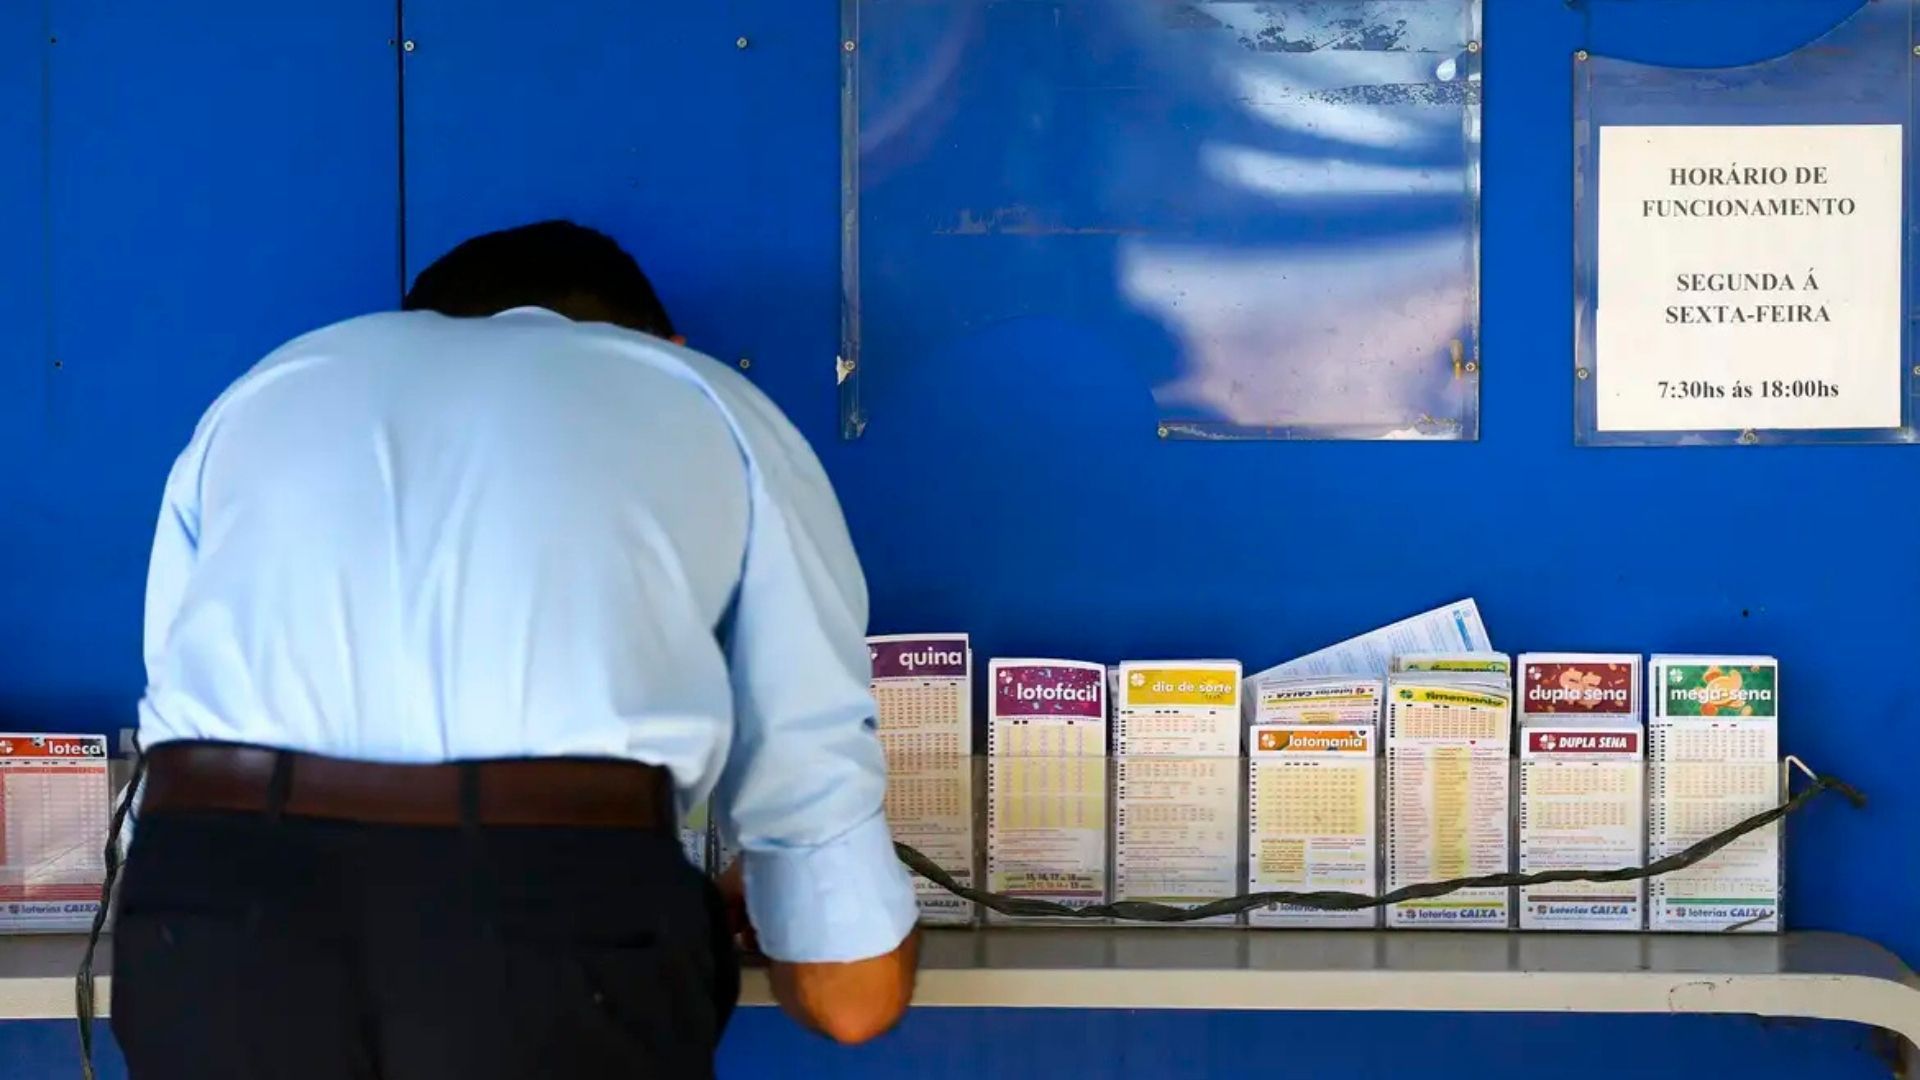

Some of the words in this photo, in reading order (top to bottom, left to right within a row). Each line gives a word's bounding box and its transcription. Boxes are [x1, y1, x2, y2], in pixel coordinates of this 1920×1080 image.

[1669, 163, 1788, 186] HORÁRIO
[1795, 166, 1828, 185] DE
[1642, 197, 1856, 217] FUNCIONAMENTO
[1676, 273, 1795, 292] SEGUNDA
[1802, 268, 1819, 291] Á
[1665, 304, 1831, 324] SEXTA-FEIRA
[1657, 379, 1726, 399] 7:30hs
[1732, 380, 1753, 398] ás
[1760, 379, 1840, 398] 18:00hs
[898, 646, 963, 671] quina
[1016, 682, 1097, 702] lotofácil
[1152, 681, 1174, 693] dia
[1178, 681, 1195, 693] de
[1199, 682, 1232, 694] sorte
[1528, 684, 1580, 704] dupla
[1583, 688, 1627, 701] sena
[1671, 688, 1772, 704] mega-sena
[48, 740, 100, 755] loteca
[1288, 735, 1363, 750] lotomania
[1559, 737, 1596, 748] DUPLA
[1598, 738, 1627, 748] SENA
[1419, 909, 1458, 919] loterias
[1459, 909, 1497, 918] CAIXA
[1590, 905, 1628, 914] CAIXA
[1688, 908, 1727, 917] loterias
[1730, 908, 1767, 917] CAIXA
